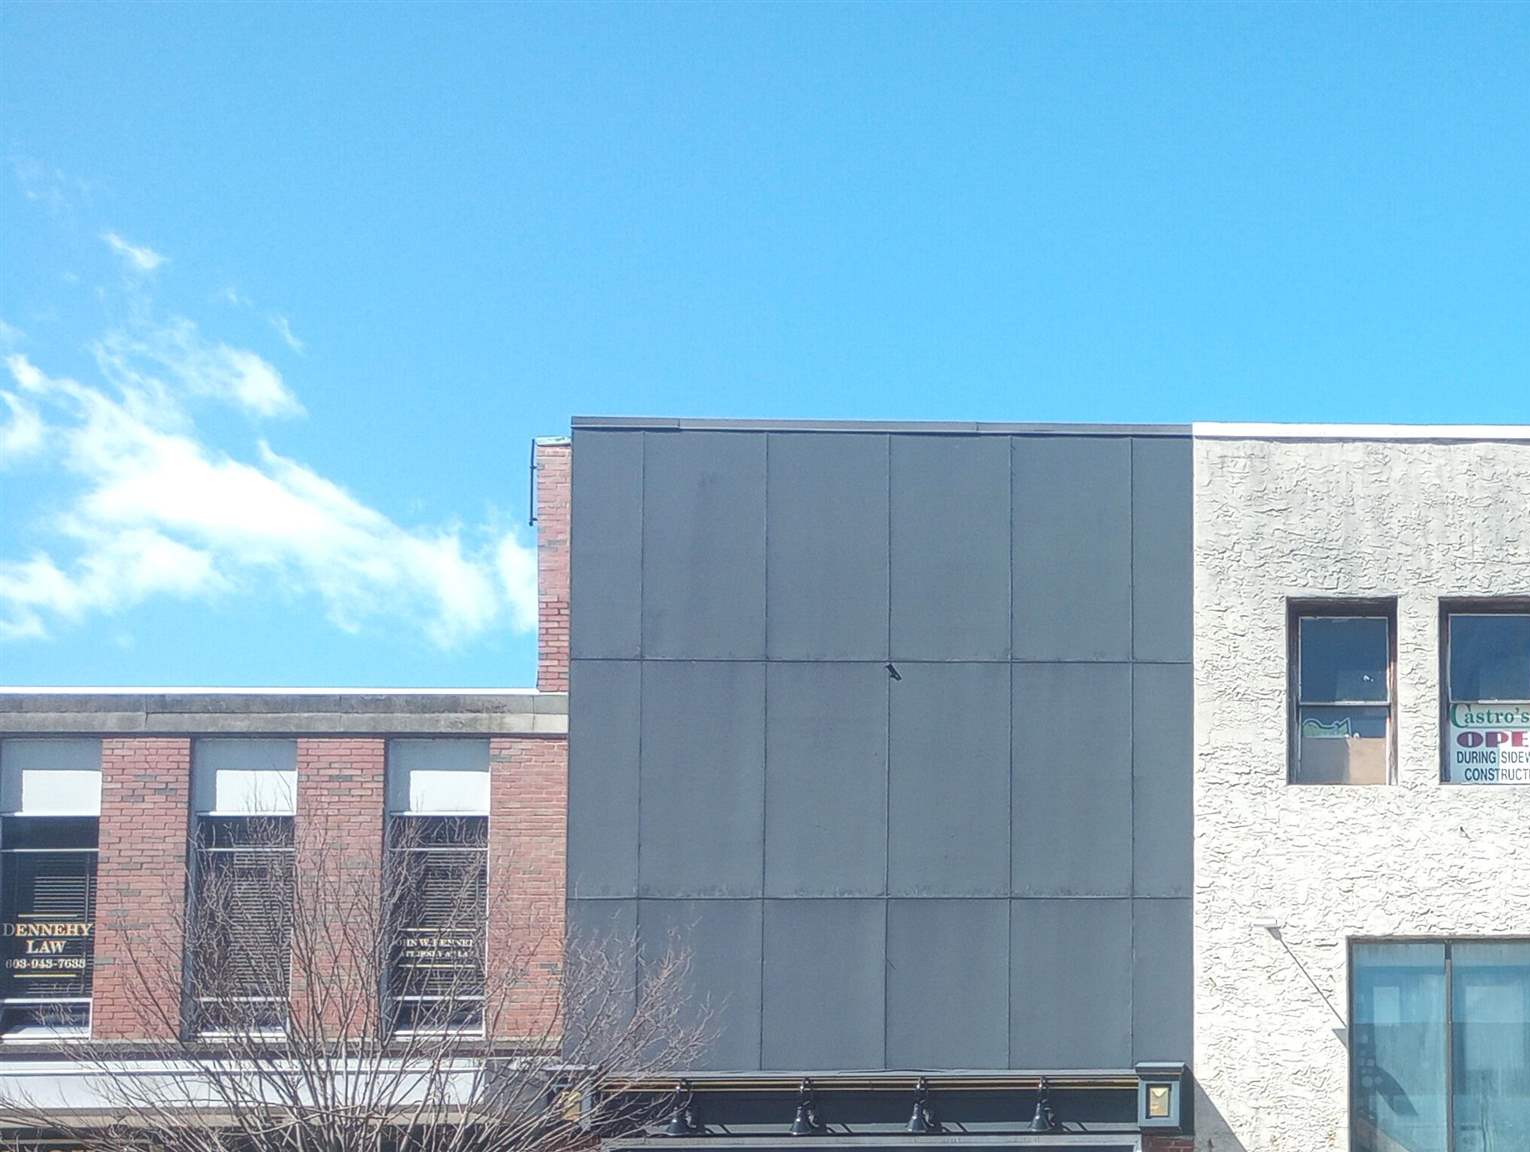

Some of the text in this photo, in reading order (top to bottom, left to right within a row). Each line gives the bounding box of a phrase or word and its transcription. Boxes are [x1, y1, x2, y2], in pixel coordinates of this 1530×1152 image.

[1456, 751, 1496, 764] DURING
[3, 923, 93, 937] DENNEHY
[26, 940, 67, 954] LAW
